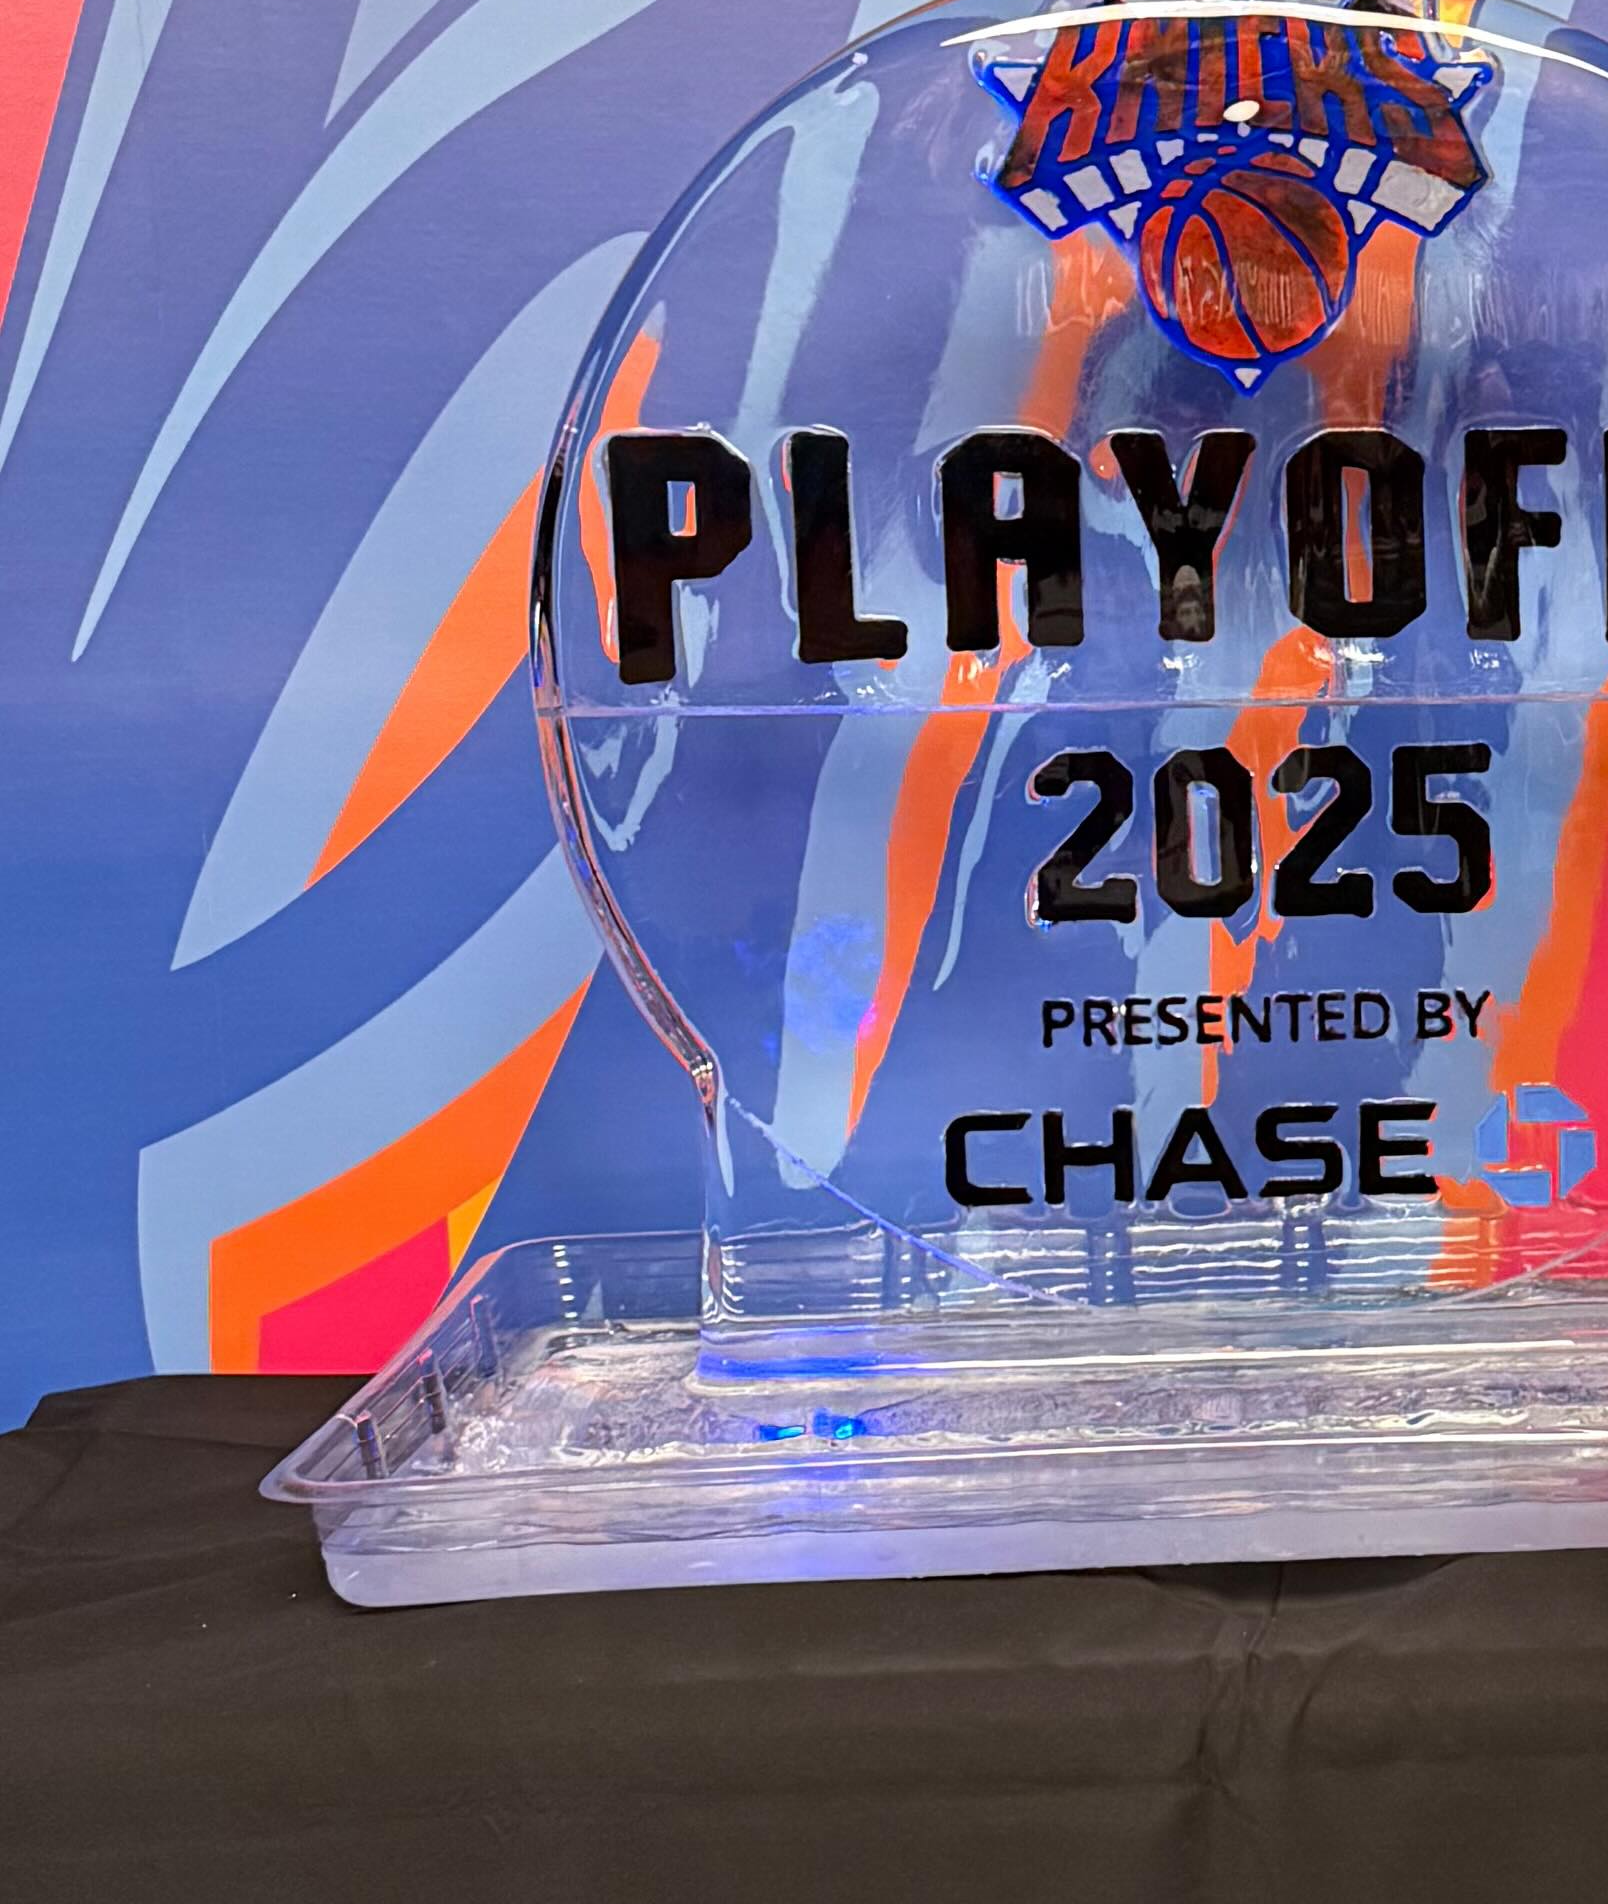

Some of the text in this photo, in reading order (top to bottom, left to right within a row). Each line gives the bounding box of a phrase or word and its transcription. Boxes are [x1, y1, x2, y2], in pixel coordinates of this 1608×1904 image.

[1030, 741, 1493, 924] 2025
[1041, 989, 1492, 1048] PRESENTED BY
[942, 1101, 1440, 1209] CHASE
